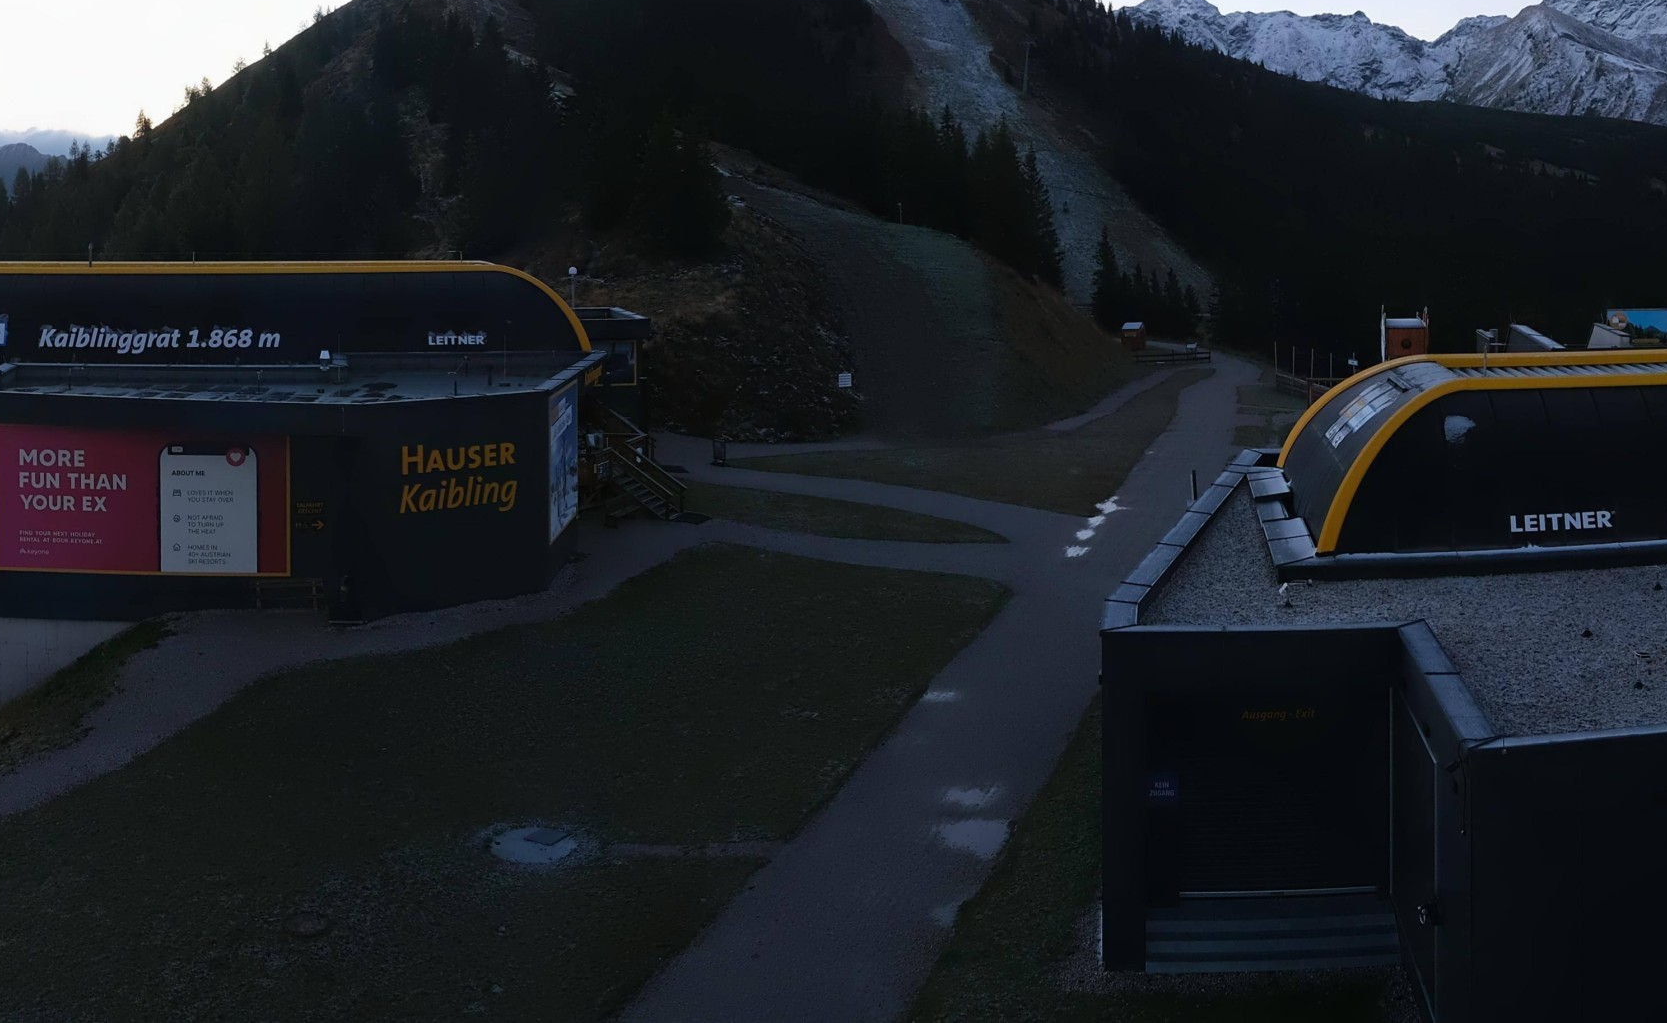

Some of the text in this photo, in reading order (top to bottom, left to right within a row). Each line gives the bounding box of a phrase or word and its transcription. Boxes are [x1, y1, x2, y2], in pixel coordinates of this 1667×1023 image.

[38, 328, 281, 355] Kaiblinggrat 1.868 m
[428, 335, 485, 346] LEITNER
[19, 448, 86, 467] MORE
[401, 442, 516, 476] HAUSER
[19, 471, 127, 490] FUN THAN
[20, 494, 107, 512] YOUR EX
[400, 476, 518, 514] Kaibling
[1509, 510, 1613, 533] LEITNER
[1240, 710, 1287, 722] Ausgang
[1295, 707, 1315, 719] Exit
